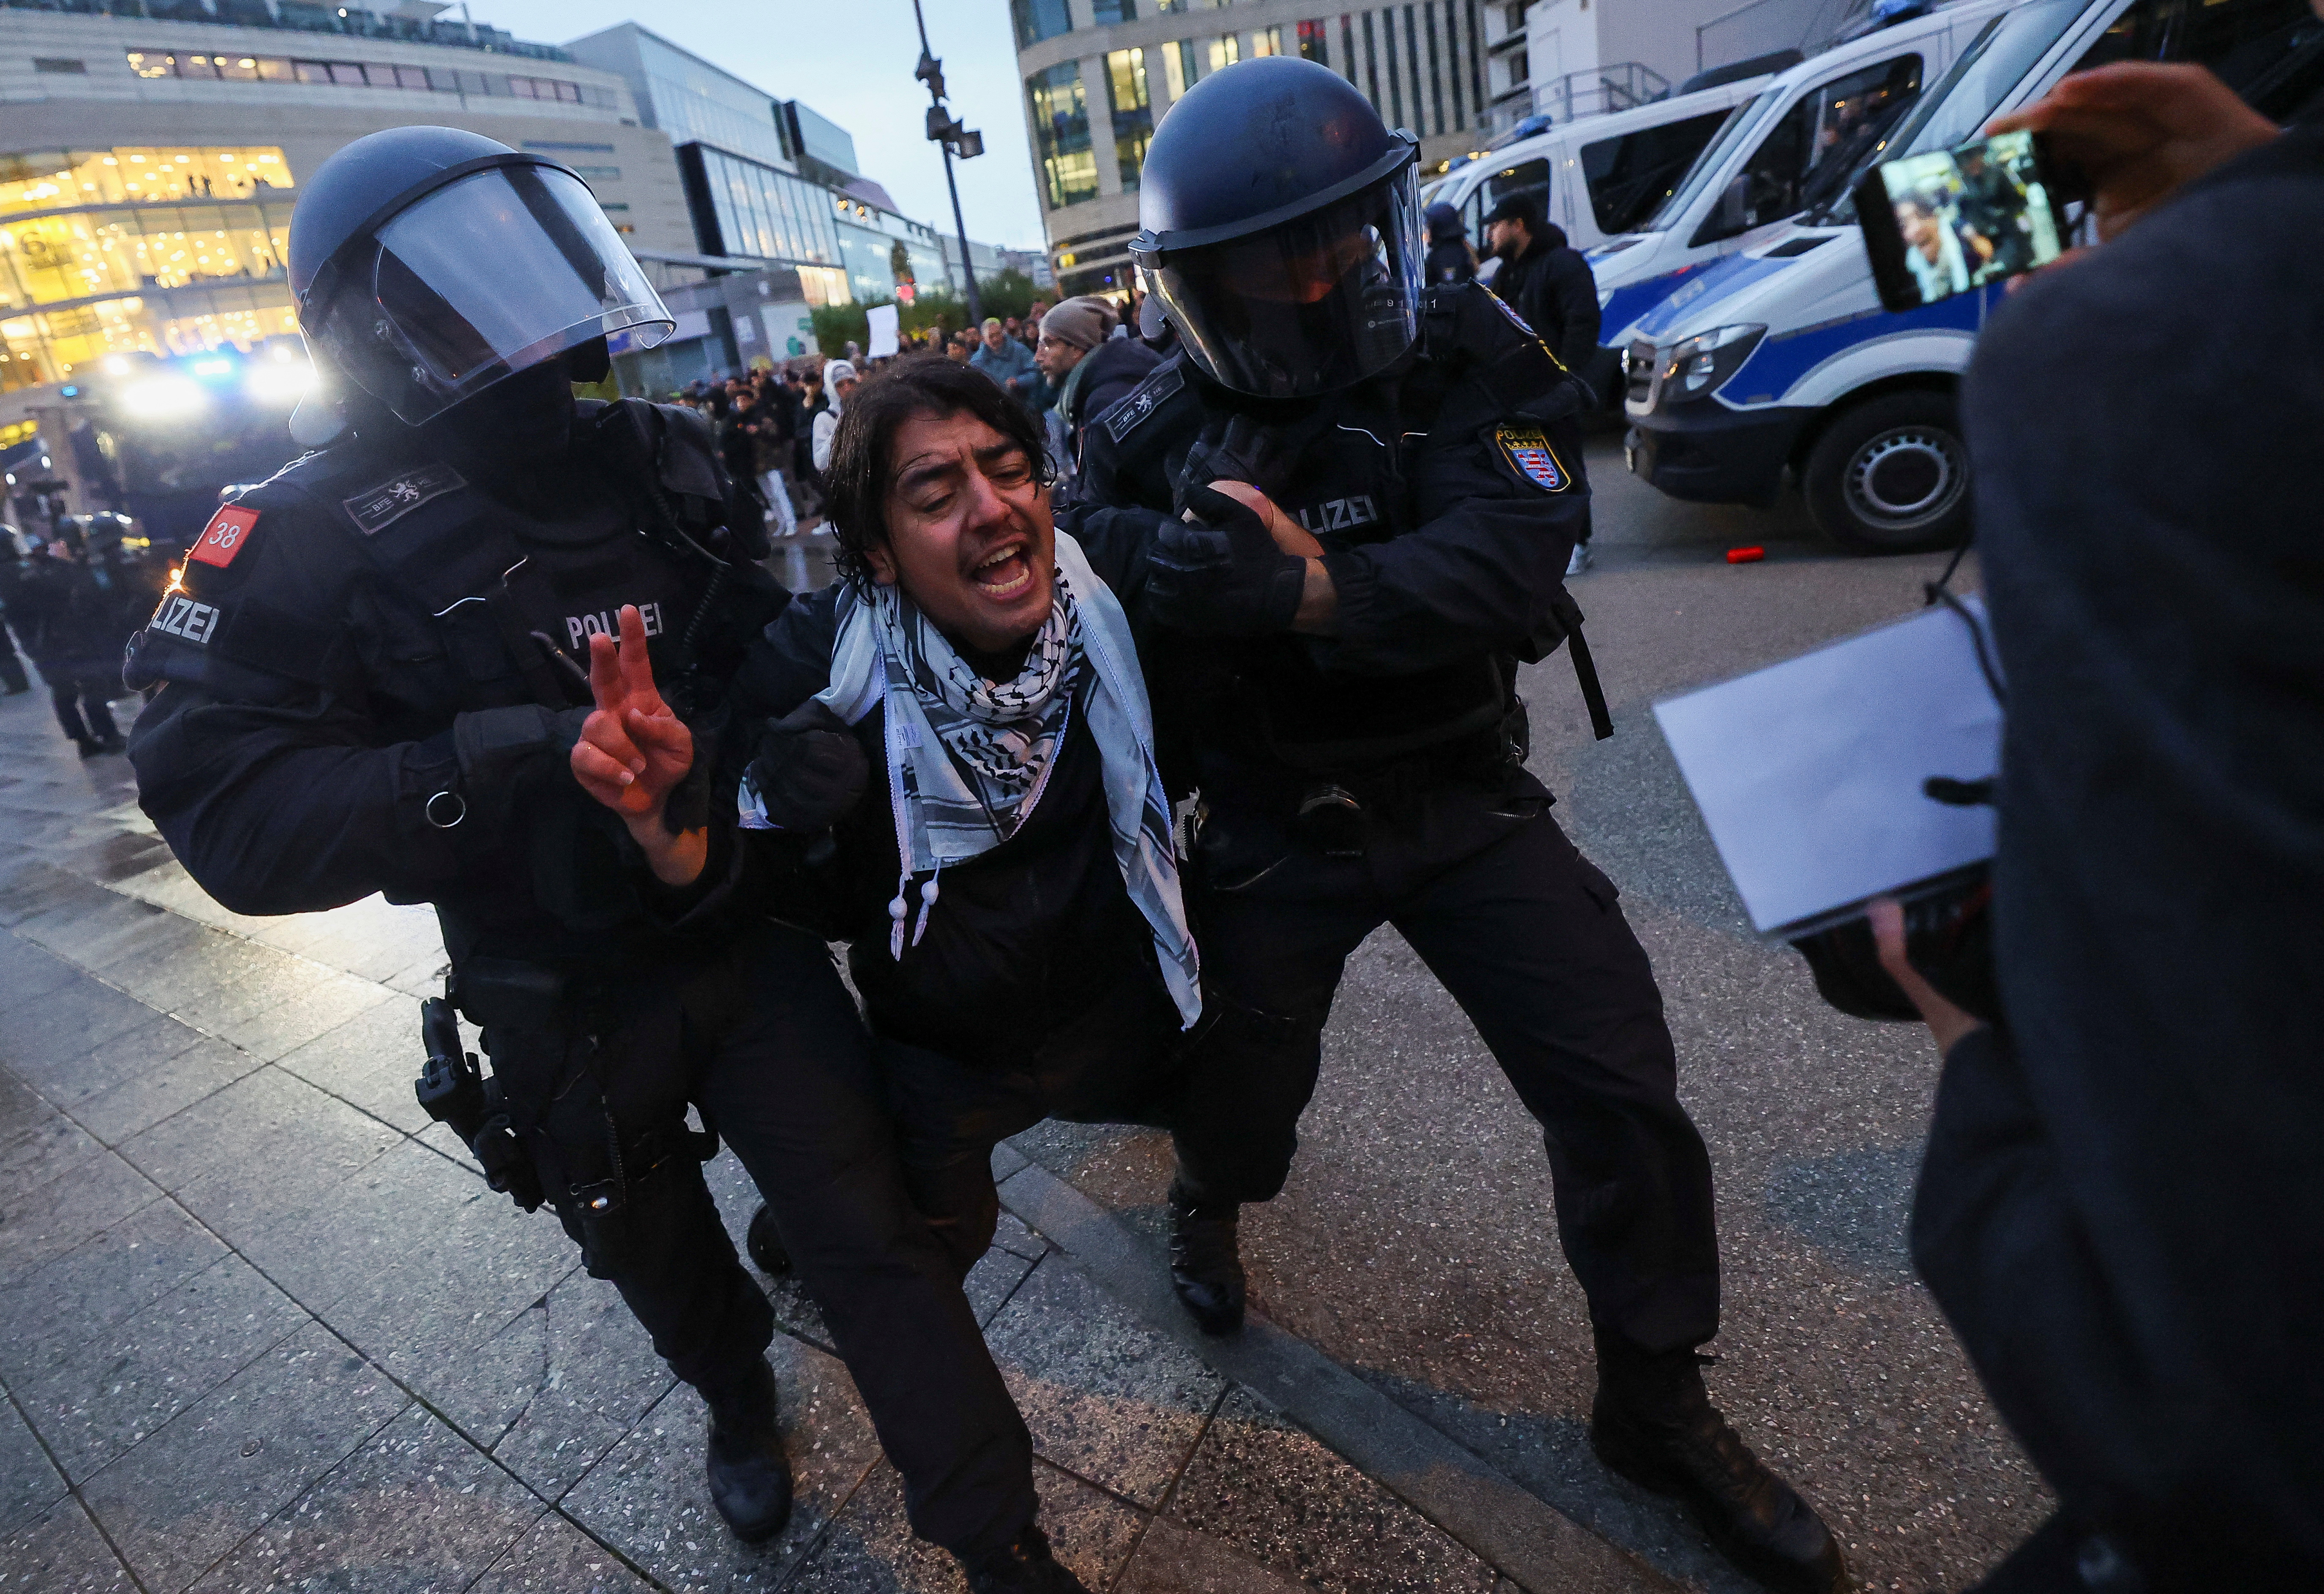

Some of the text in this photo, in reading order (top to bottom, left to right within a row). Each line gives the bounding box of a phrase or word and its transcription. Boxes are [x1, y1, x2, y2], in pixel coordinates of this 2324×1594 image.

[1123, 409, 1136, 422] BFE
[1497, 430, 1542, 440] POLIZEI
[371, 497, 393, 512] BFE
[1286, 495, 1378, 534] LIZEI
[208, 521, 240, 549] 38
[566, 602, 663, 649] POLEI
